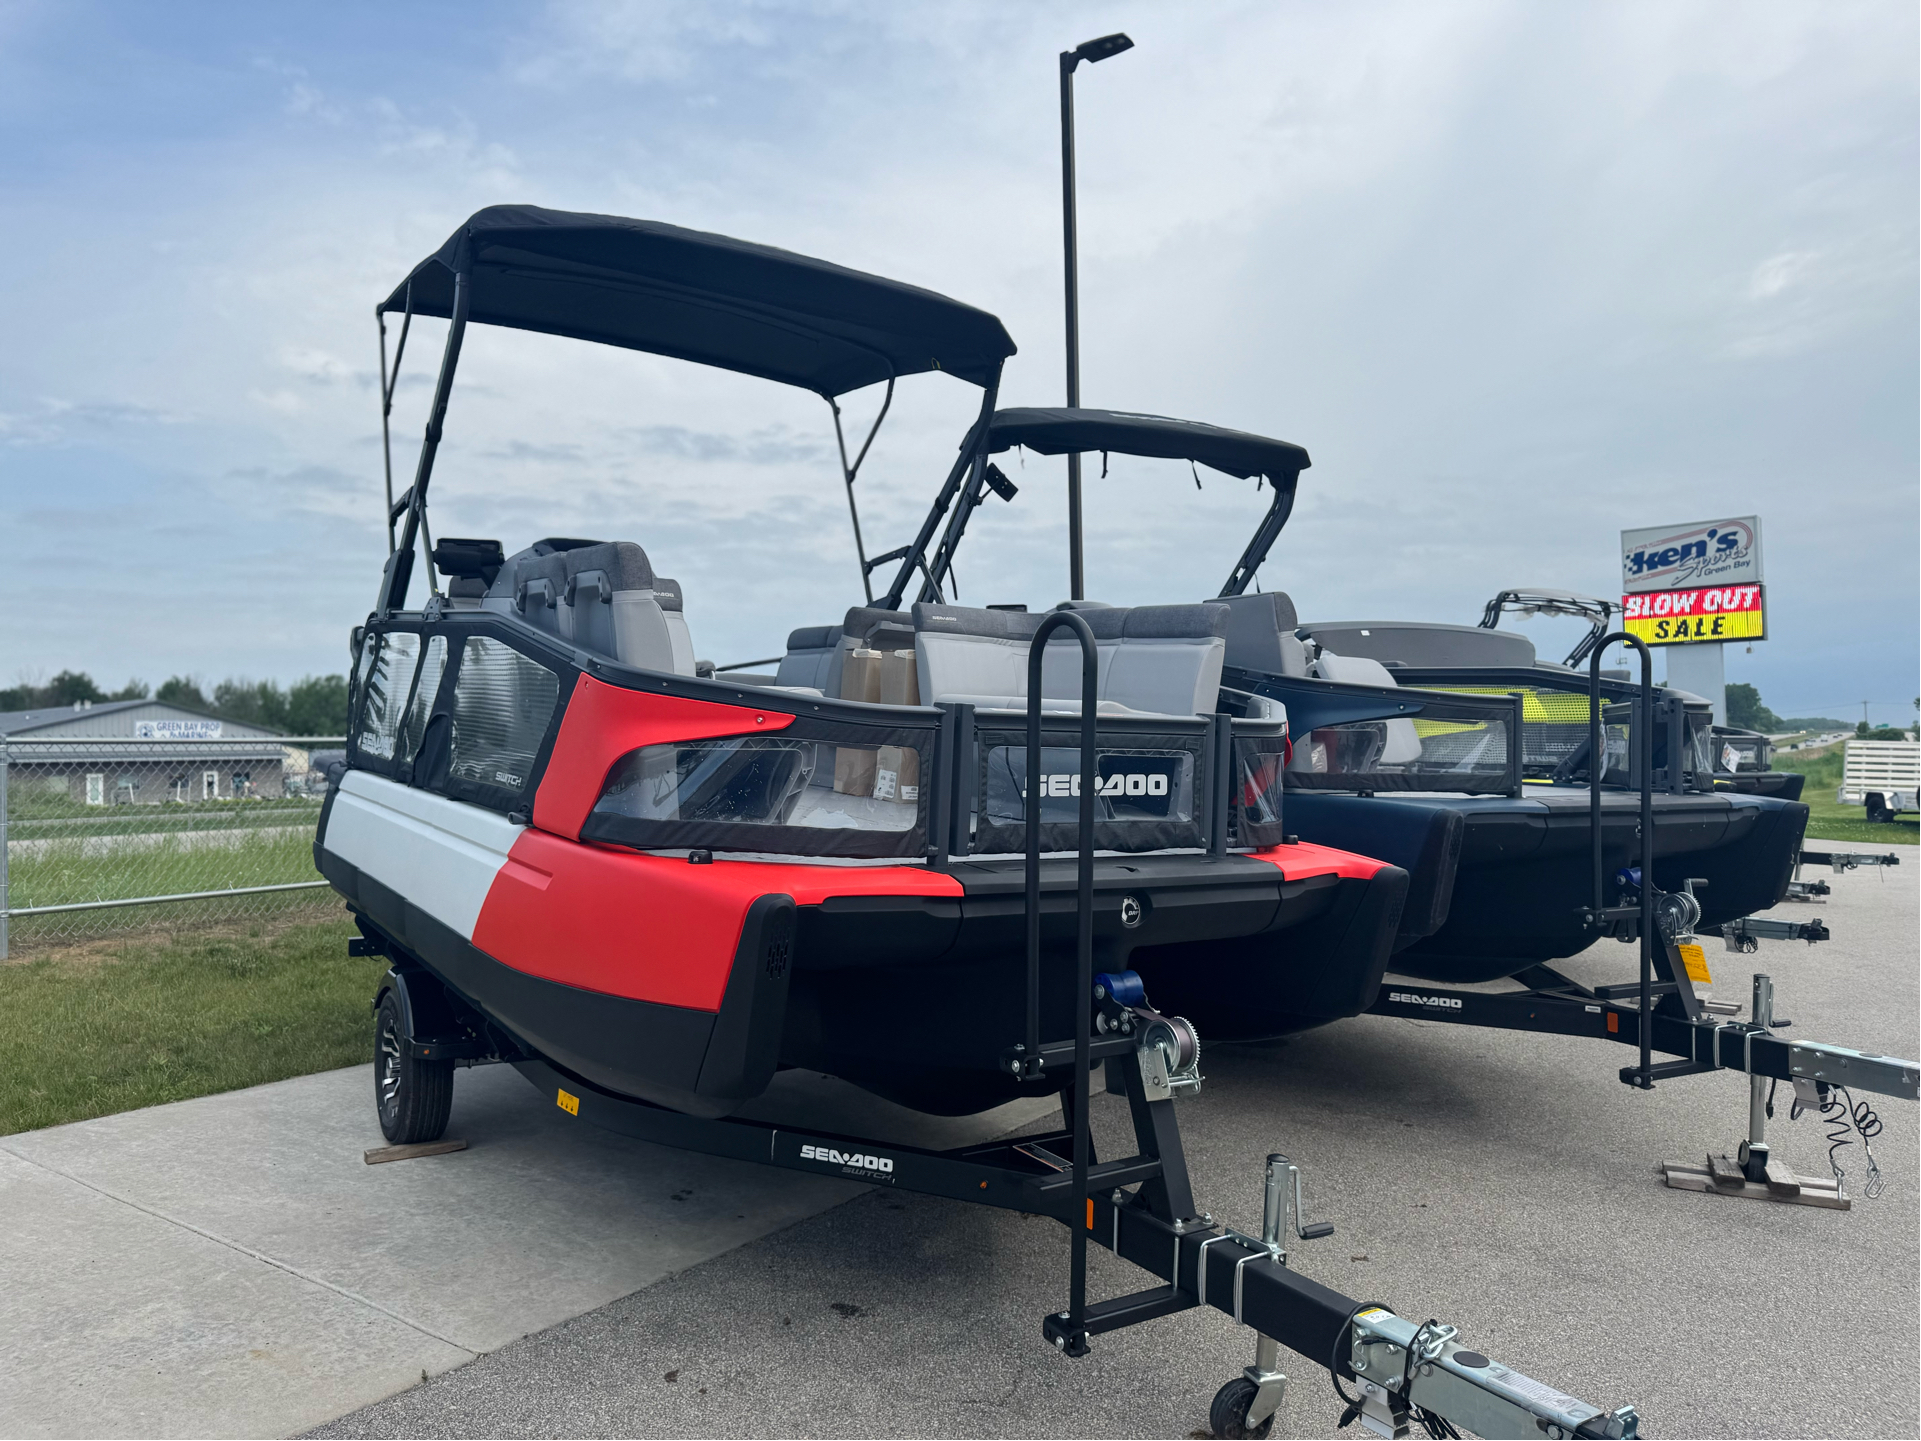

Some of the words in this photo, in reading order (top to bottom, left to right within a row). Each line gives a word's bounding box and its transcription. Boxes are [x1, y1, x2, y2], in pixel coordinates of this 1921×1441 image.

[1671, 545, 1749, 586] Sports
[1704, 564, 1731, 576] Green
[1733, 559, 1751, 574] Bay
[1624, 591, 1698, 617] BLOW
[1703, 585, 1759, 612] OUT
[1655, 616, 1726, 639] SALE
[156, 722, 182, 731] GREEN
[184, 722, 199, 731] BAY
[200, 722, 220, 731] PROP
[842, 1166, 892, 1180] SWITCH
